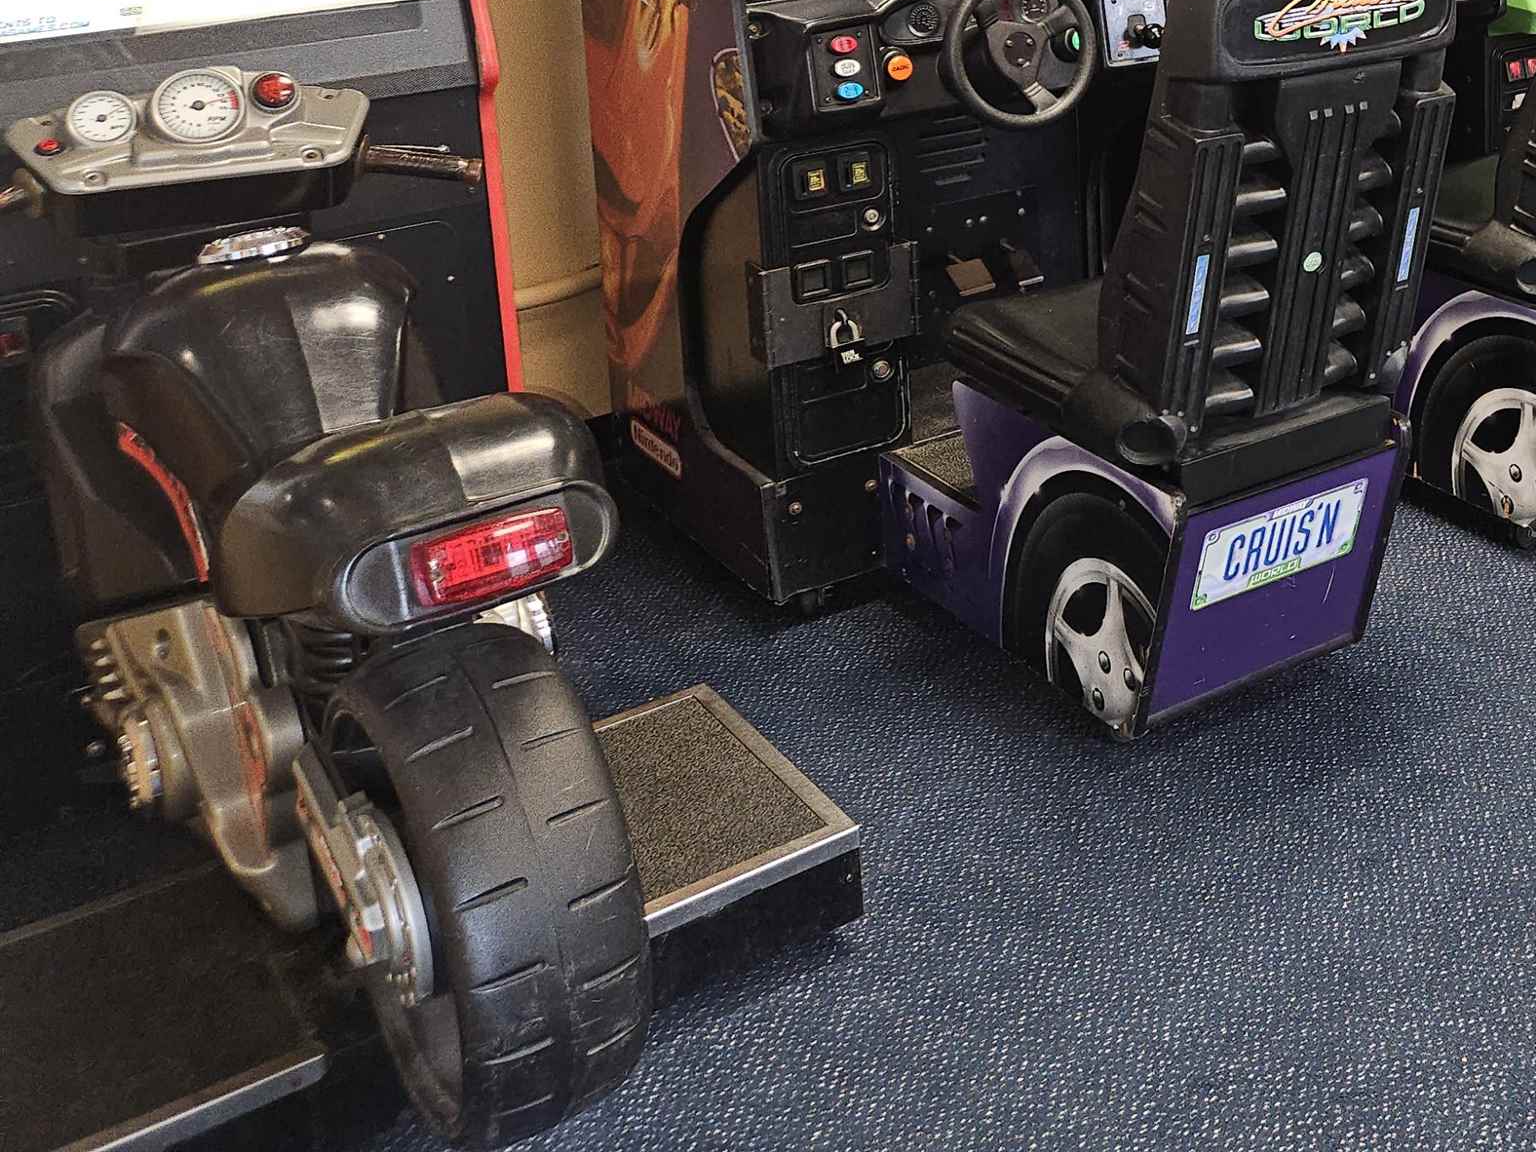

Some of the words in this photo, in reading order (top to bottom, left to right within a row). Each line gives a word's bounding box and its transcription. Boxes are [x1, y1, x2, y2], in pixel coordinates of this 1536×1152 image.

[1254, 0, 1426, 42] WORLD
[1223, 499, 1341, 581] CRUIS'N
[1250, 559, 1298, 585] WORLD
